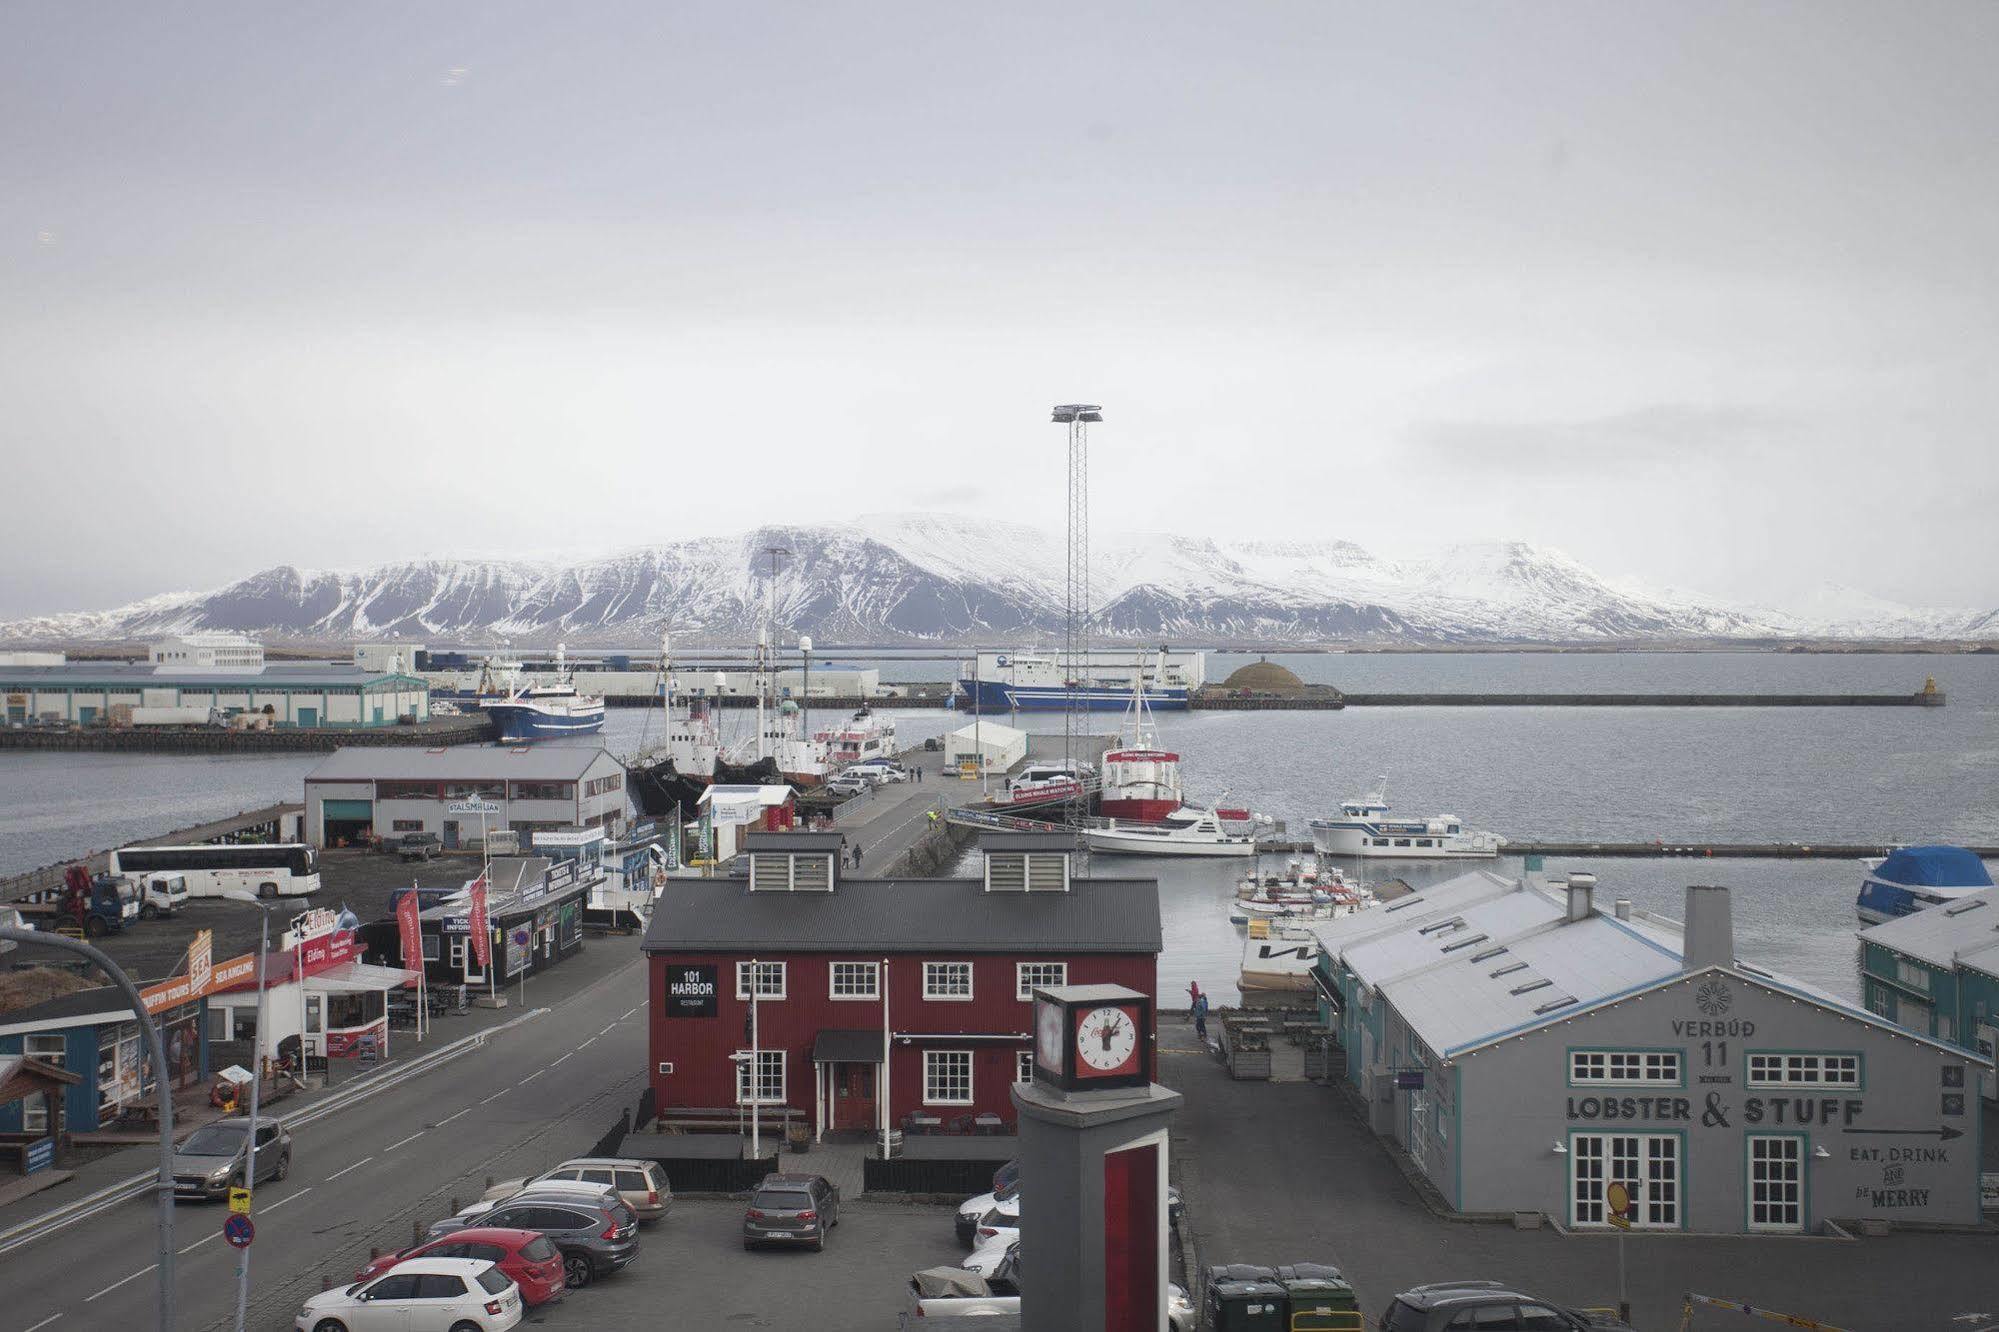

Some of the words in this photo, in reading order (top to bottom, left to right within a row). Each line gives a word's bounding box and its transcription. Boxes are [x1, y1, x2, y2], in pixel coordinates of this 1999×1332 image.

[307, 949, 325, 962] Elding
[684, 971, 700, 982] 101
[671, 983, 713, 995] HARBOR
[1672, 1018, 1755, 1037] VERBÚÐ
[1701, 1041, 1728, 1066] 11
[1566, 1097, 1691, 1120] LOBSTER
[1702, 1091, 1730, 1128] &
[1745, 1098, 1863, 1124] STUFF
[1850, 1148, 1884, 1162] EAT,
[1889, 1148, 1948, 1162] DRINK
[1871, 1190, 1930, 1208] MERRY
